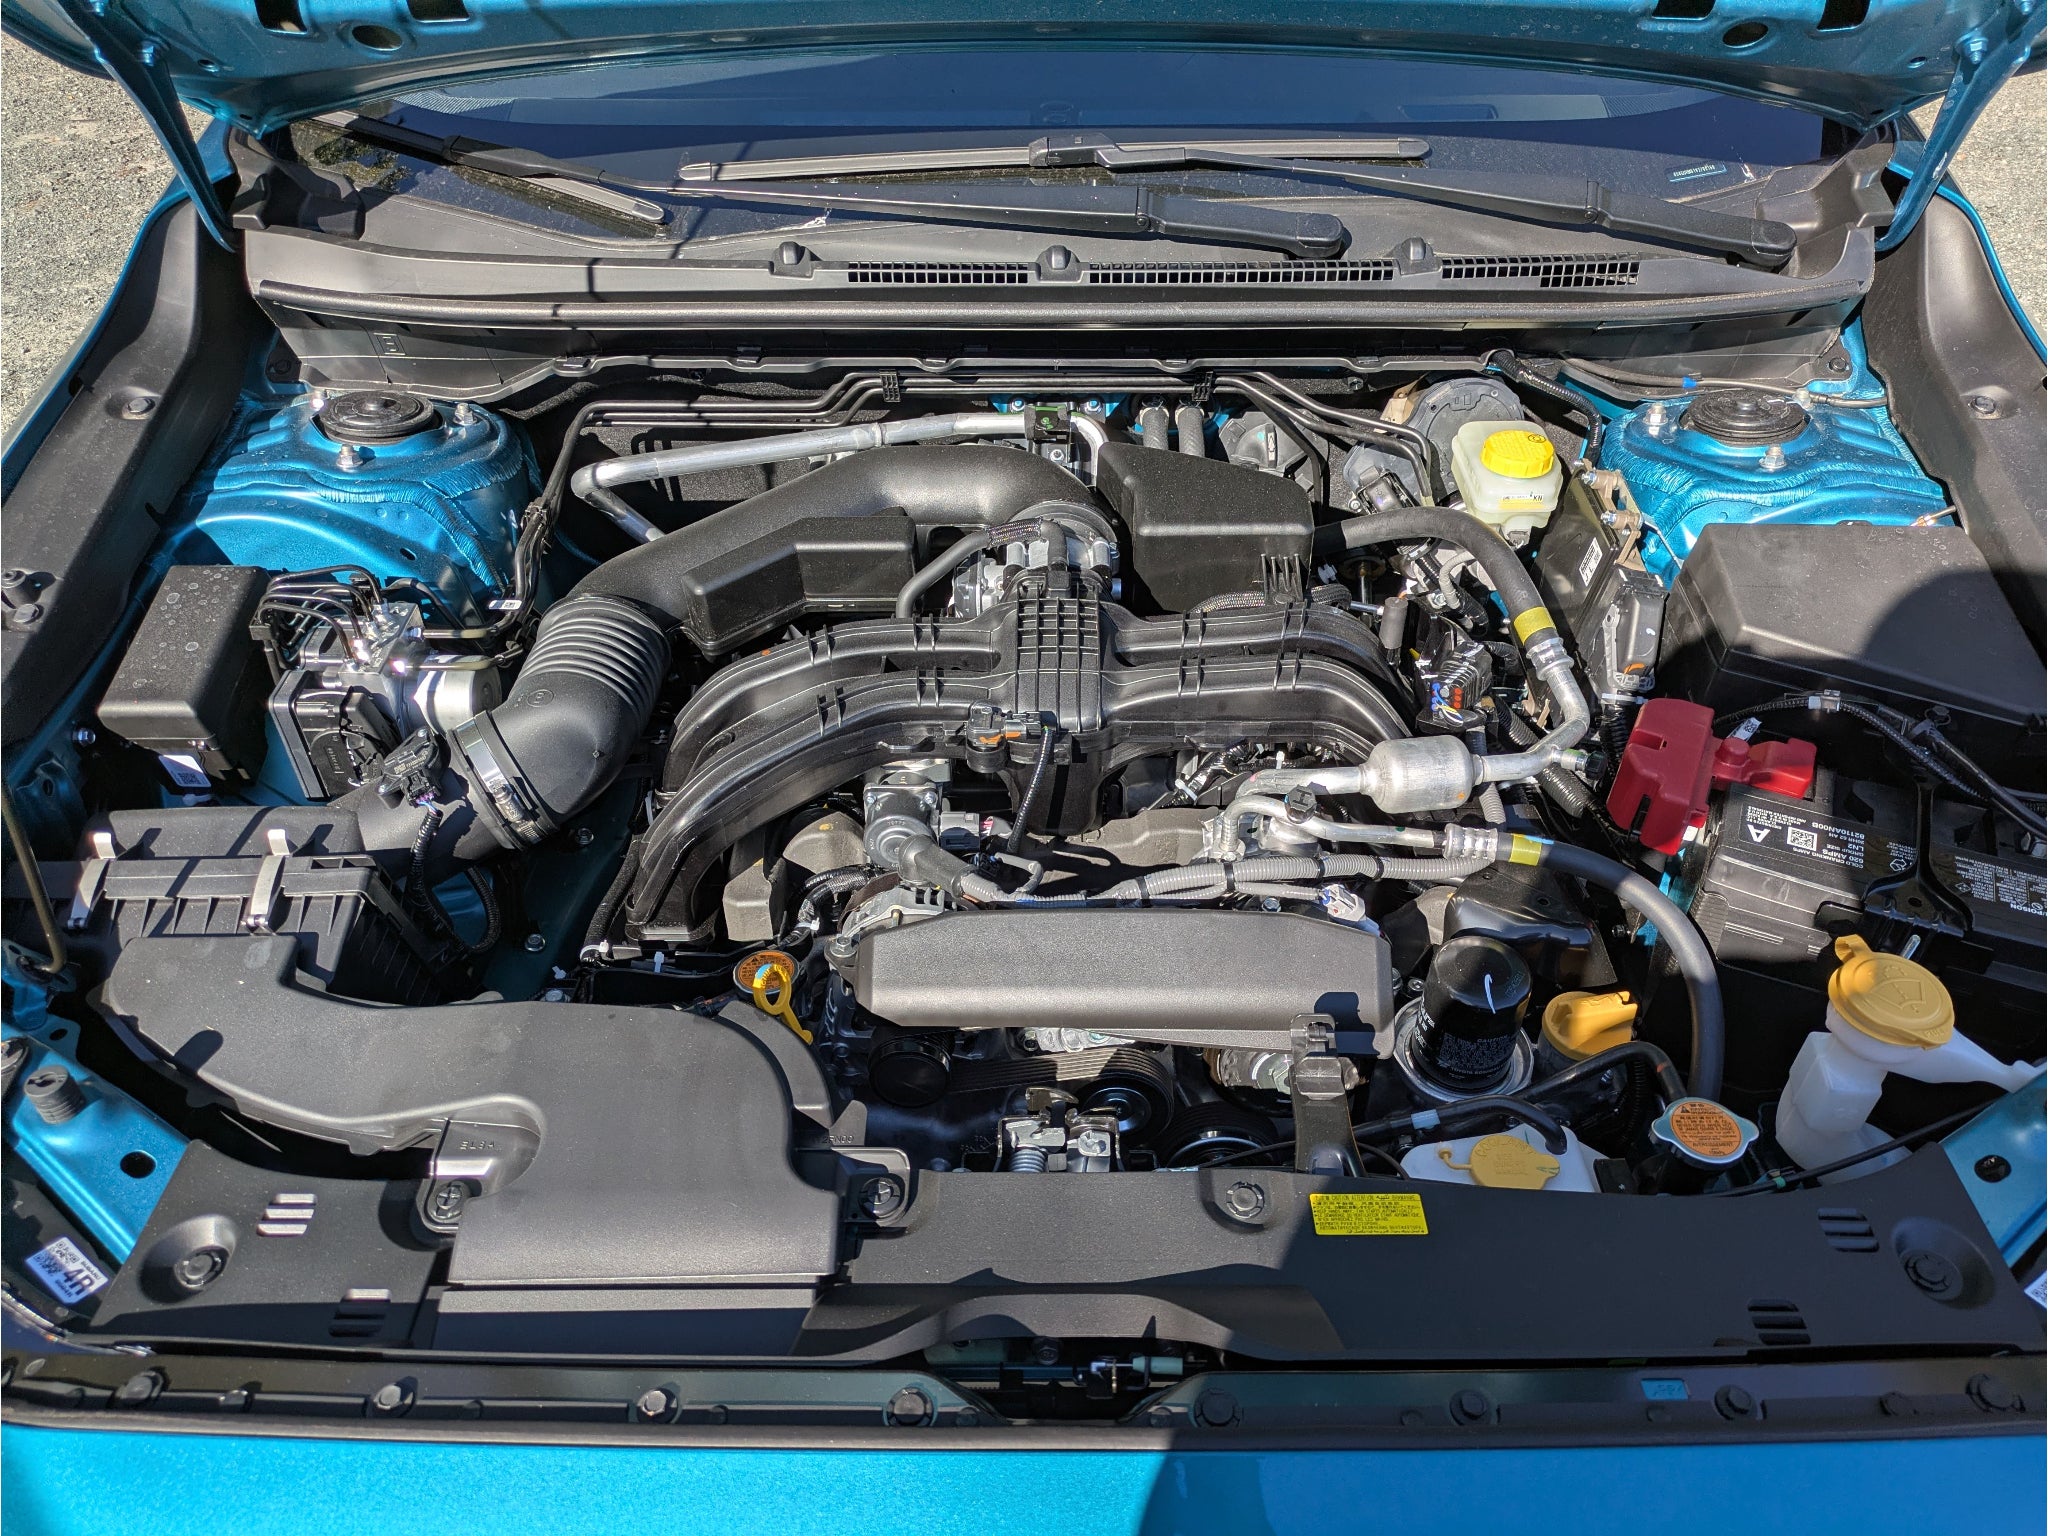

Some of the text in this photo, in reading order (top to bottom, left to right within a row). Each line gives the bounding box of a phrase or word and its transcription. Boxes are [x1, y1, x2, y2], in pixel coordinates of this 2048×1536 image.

[1822, 849, 1864, 864] 620 AMPS
[1847, 843, 1864, 852] LN2
[1792, 847, 1864, 869] COLD CRANKING AMPS
[81, 1261, 102, 1280] SUBARU
[64, 1268, 95, 1296] 4R
